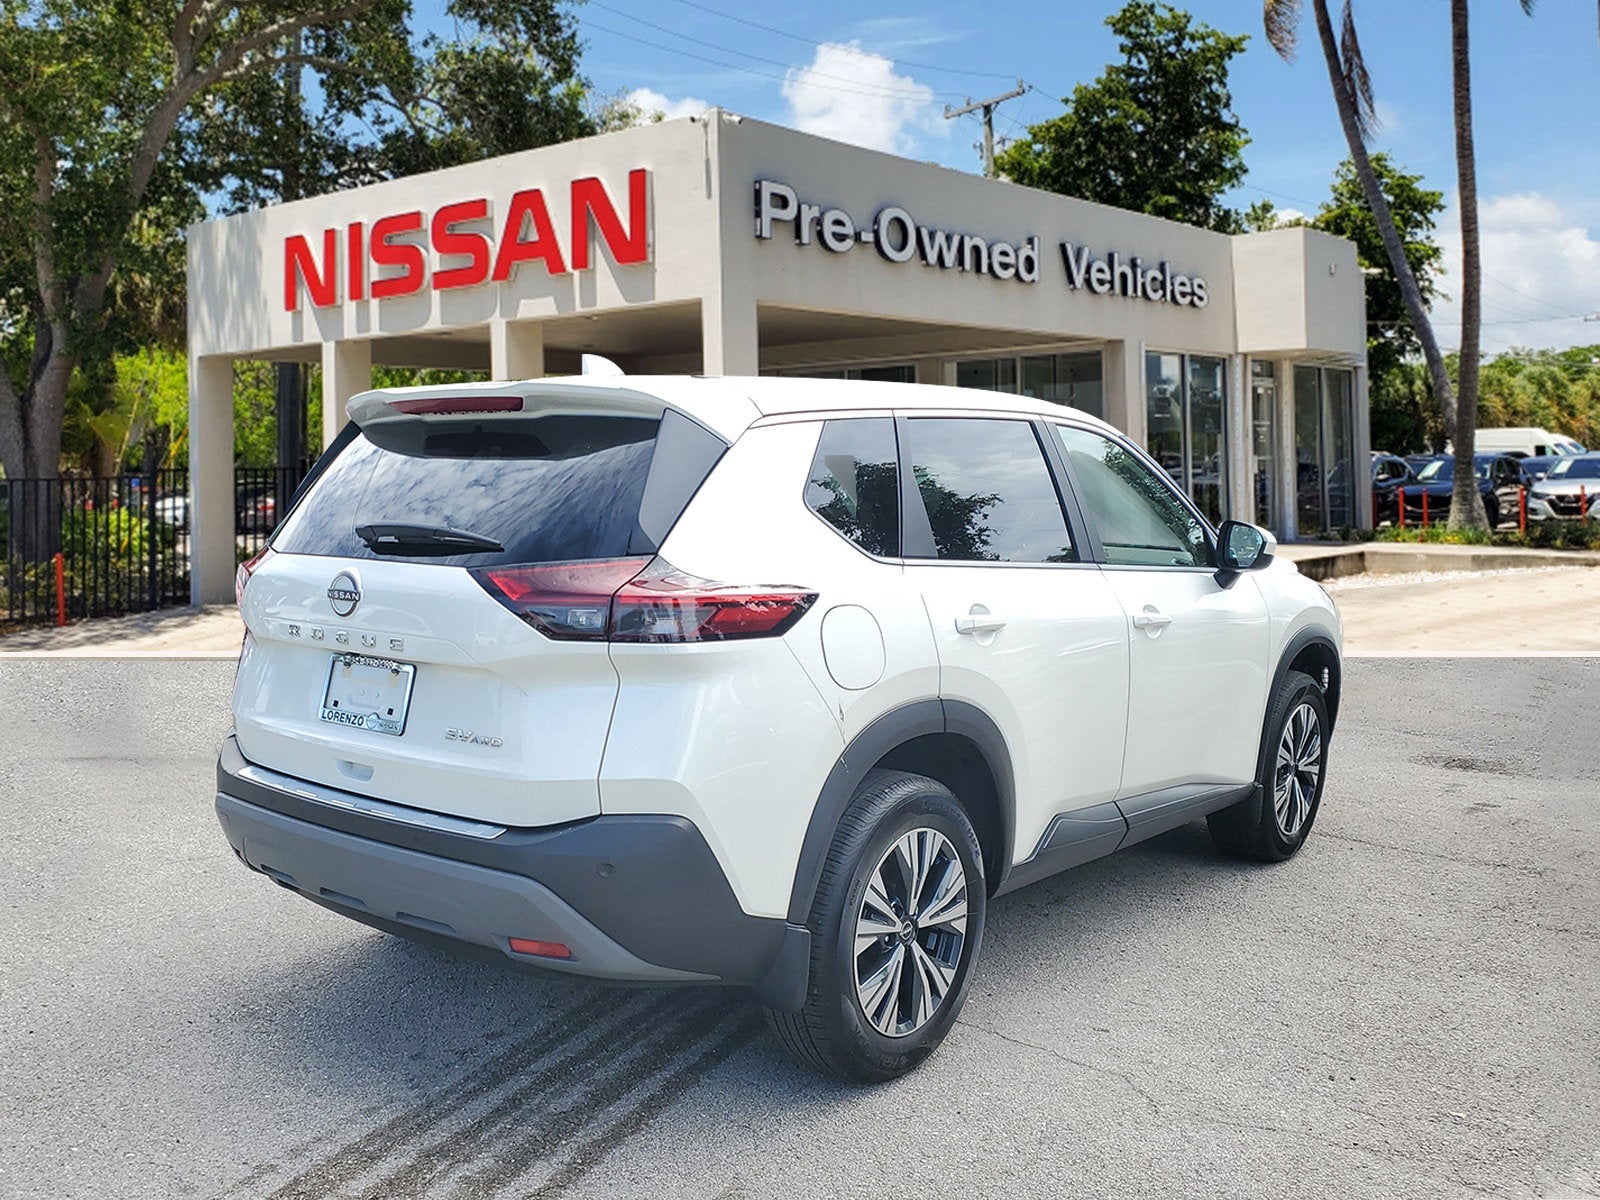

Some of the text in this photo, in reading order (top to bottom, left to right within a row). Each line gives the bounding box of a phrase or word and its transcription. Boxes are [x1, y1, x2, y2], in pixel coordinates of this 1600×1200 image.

[284, 168, 650, 312] NISSAN
[754, 179, 1209, 309] Pre-Owned Vehicles
[288, 624, 404, 652] ROGUE
[321, 709, 365, 727] LORENZO
